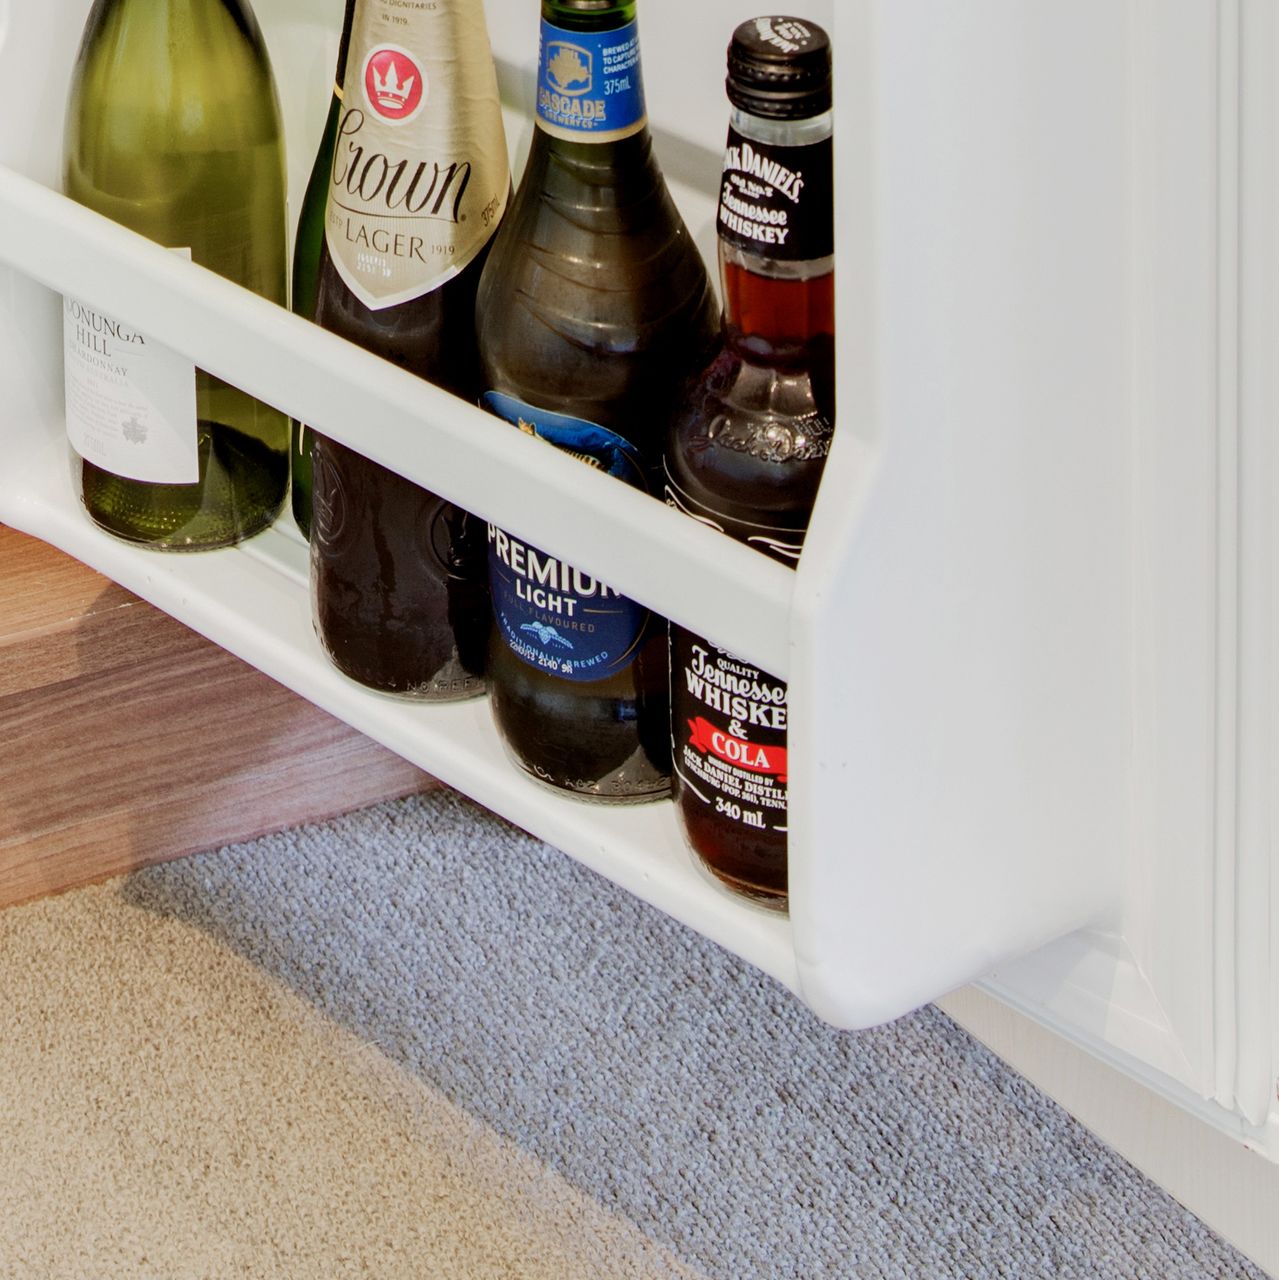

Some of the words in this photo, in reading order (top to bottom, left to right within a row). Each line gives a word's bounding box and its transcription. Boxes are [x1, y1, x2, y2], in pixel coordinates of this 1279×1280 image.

[382, 14, 390, 22] IN
[389, 0, 437, 10] DIGNITARIES
[602, 43, 629, 57] BREWED
[604, 76, 631, 96] 375mL
[540, 86, 606, 121] CASCADE
[332, 108, 472, 224] Crown
[722, 182, 788, 226] Tennessee
[346, 217, 427, 264] LAGER
[431, 244, 455, 256] 1919
[720, 204, 789, 245] WHISKEY
[76, 325, 111, 357] HILL
[516, 578, 577, 616] LIGHT
[528, 606, 595, 633] FLAVOURED
[567, 651, 609, 669] BREWED
[691, 645, 788, 705] Tennesse
[716, 657, 759, 680] QUALITY
[685, 666, 787, 730] WHISKE
[728, 719, 748, 740] &
[712, 732, 770, 769] COLA
[683, 745, 703, 769] JACK
[704, 761, 742, 791] DANIEL
[744, 780, 787, 801] DISTIL
[764, 778, 774, 787] BY
[715, 796, 741, 821] 340
[742, 810, 766, 829] mL
